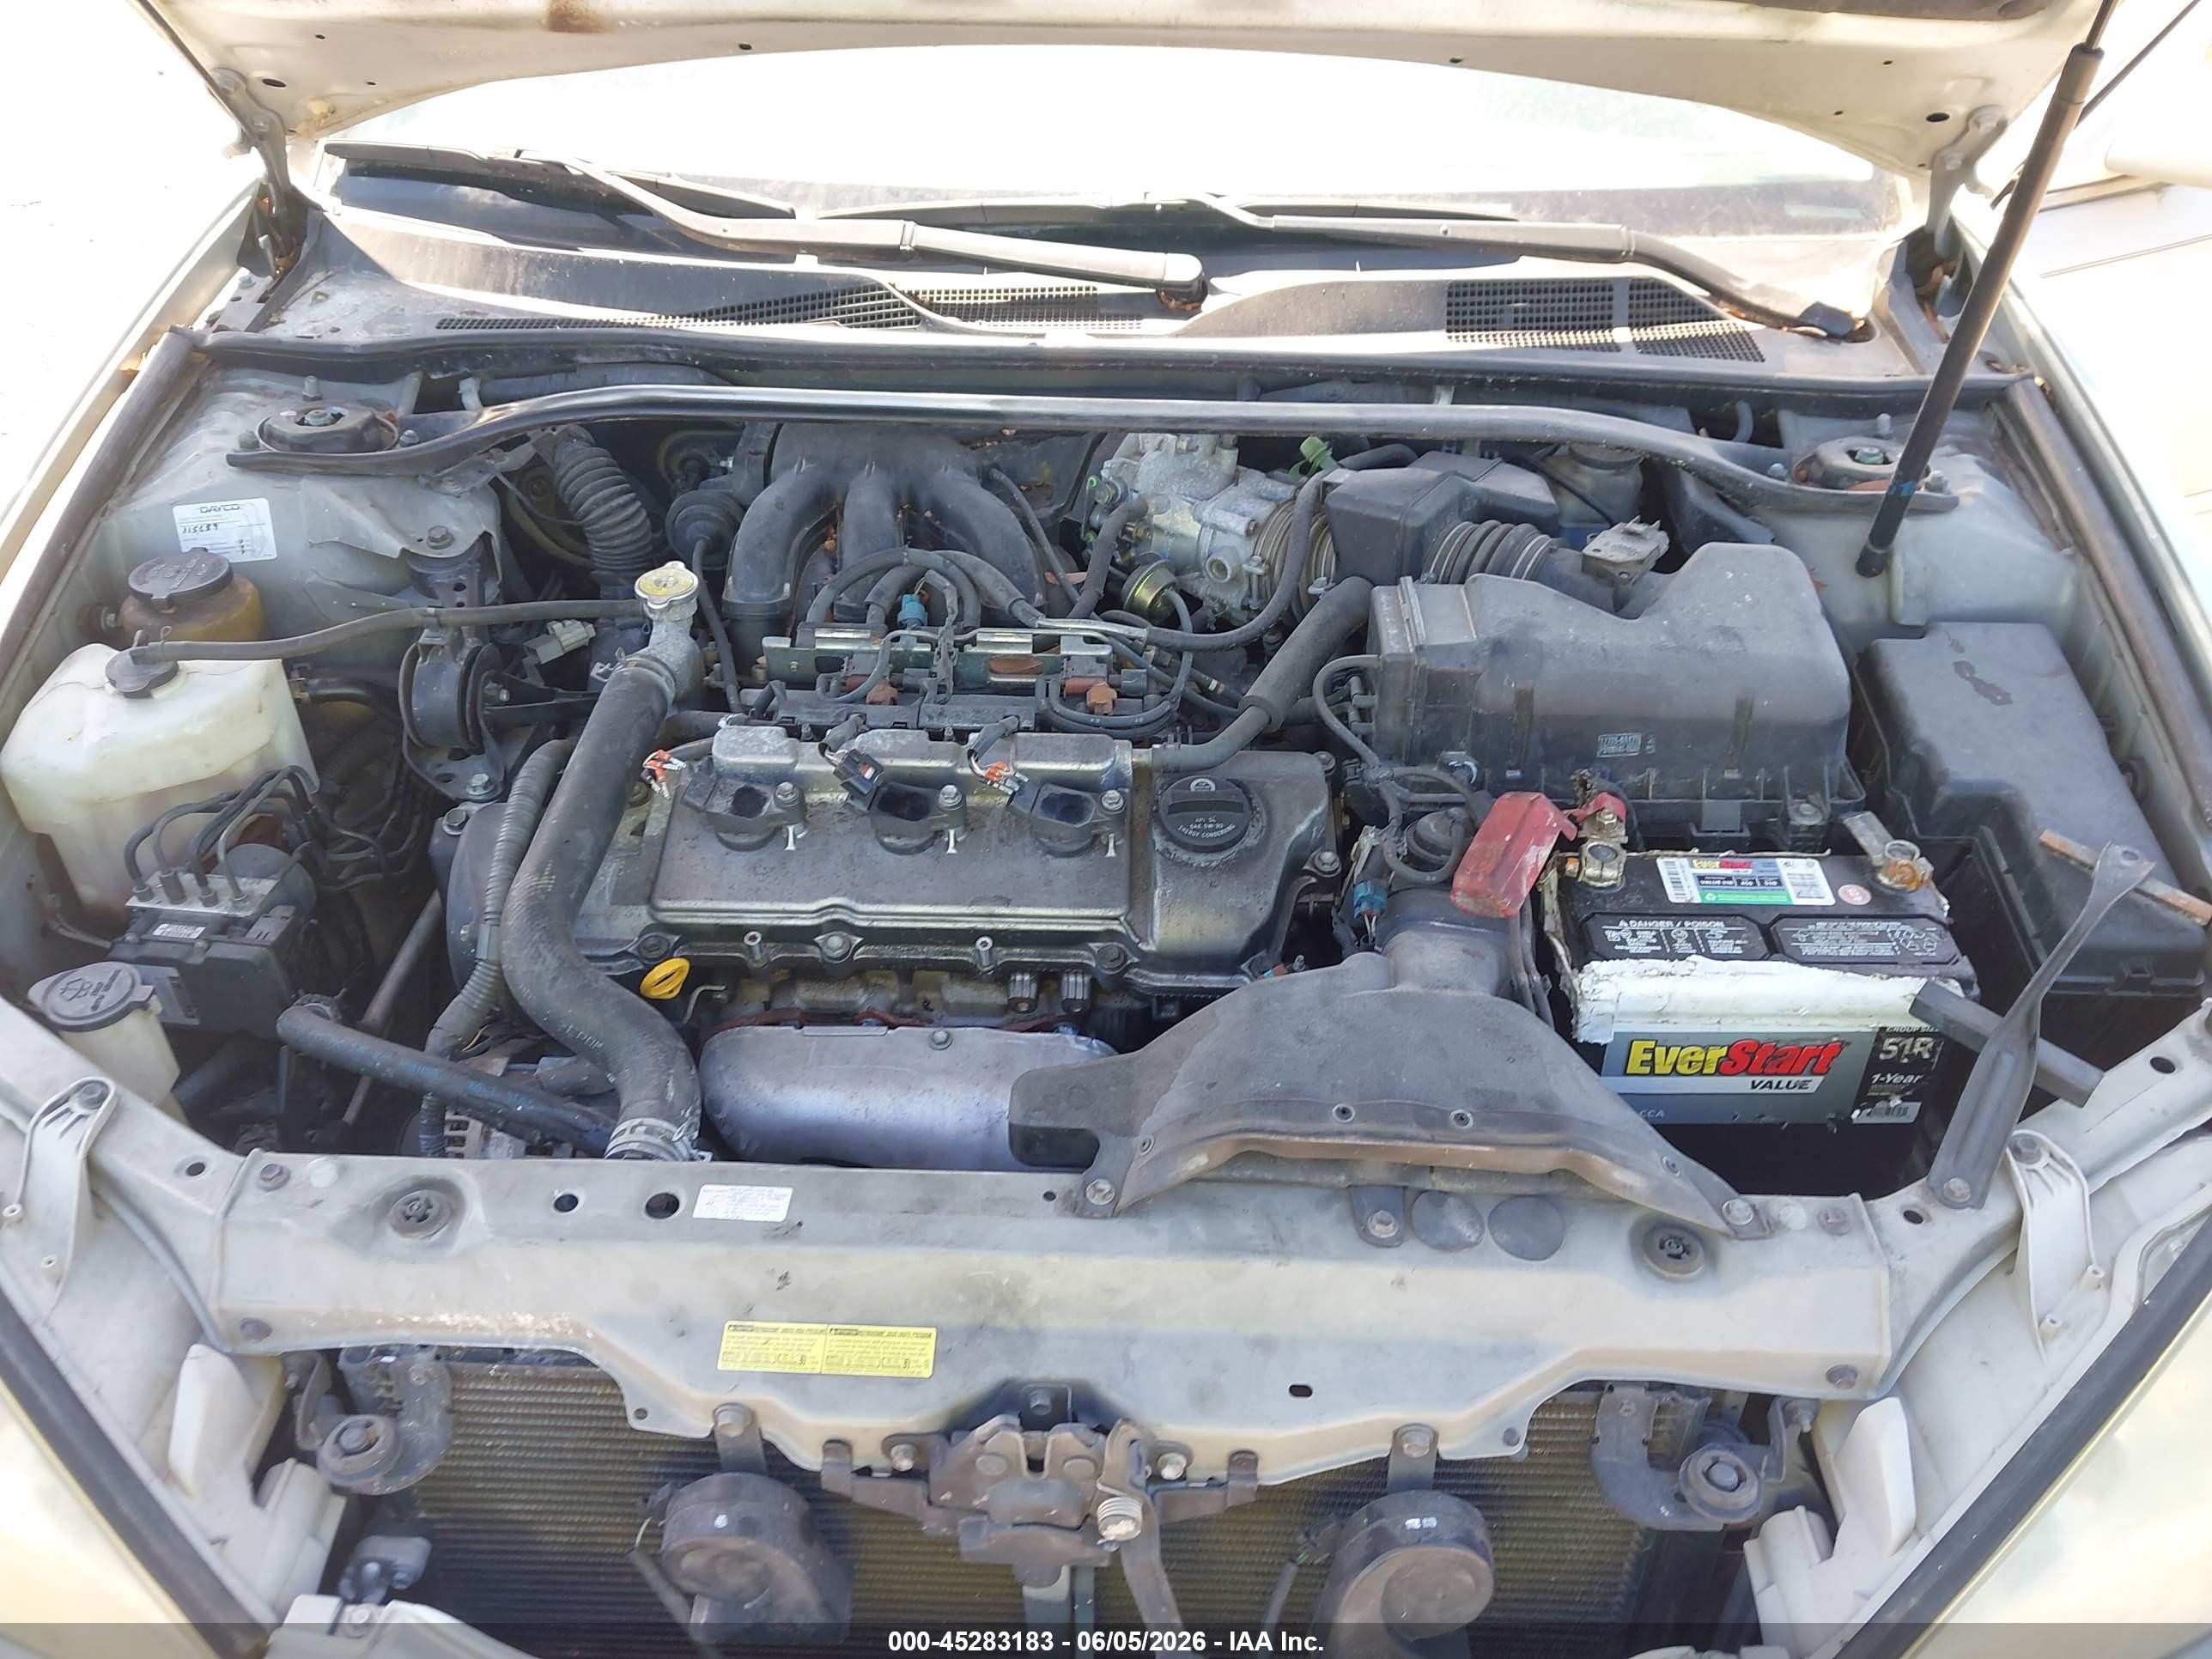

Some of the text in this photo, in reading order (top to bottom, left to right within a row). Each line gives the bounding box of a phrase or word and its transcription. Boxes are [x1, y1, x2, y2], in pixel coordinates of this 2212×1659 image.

[199, 503, 240, 514] DAYCO
[1879, 1036, 1936, 1063] 51R
[1626, 1038, 1847, 1076] EverStart
[1871, 1073, 1924, 1084] 1-Year
[1750, 1079, 1813, 1091] VALUE
[1639, 1109, 1664, 1118] CCA
